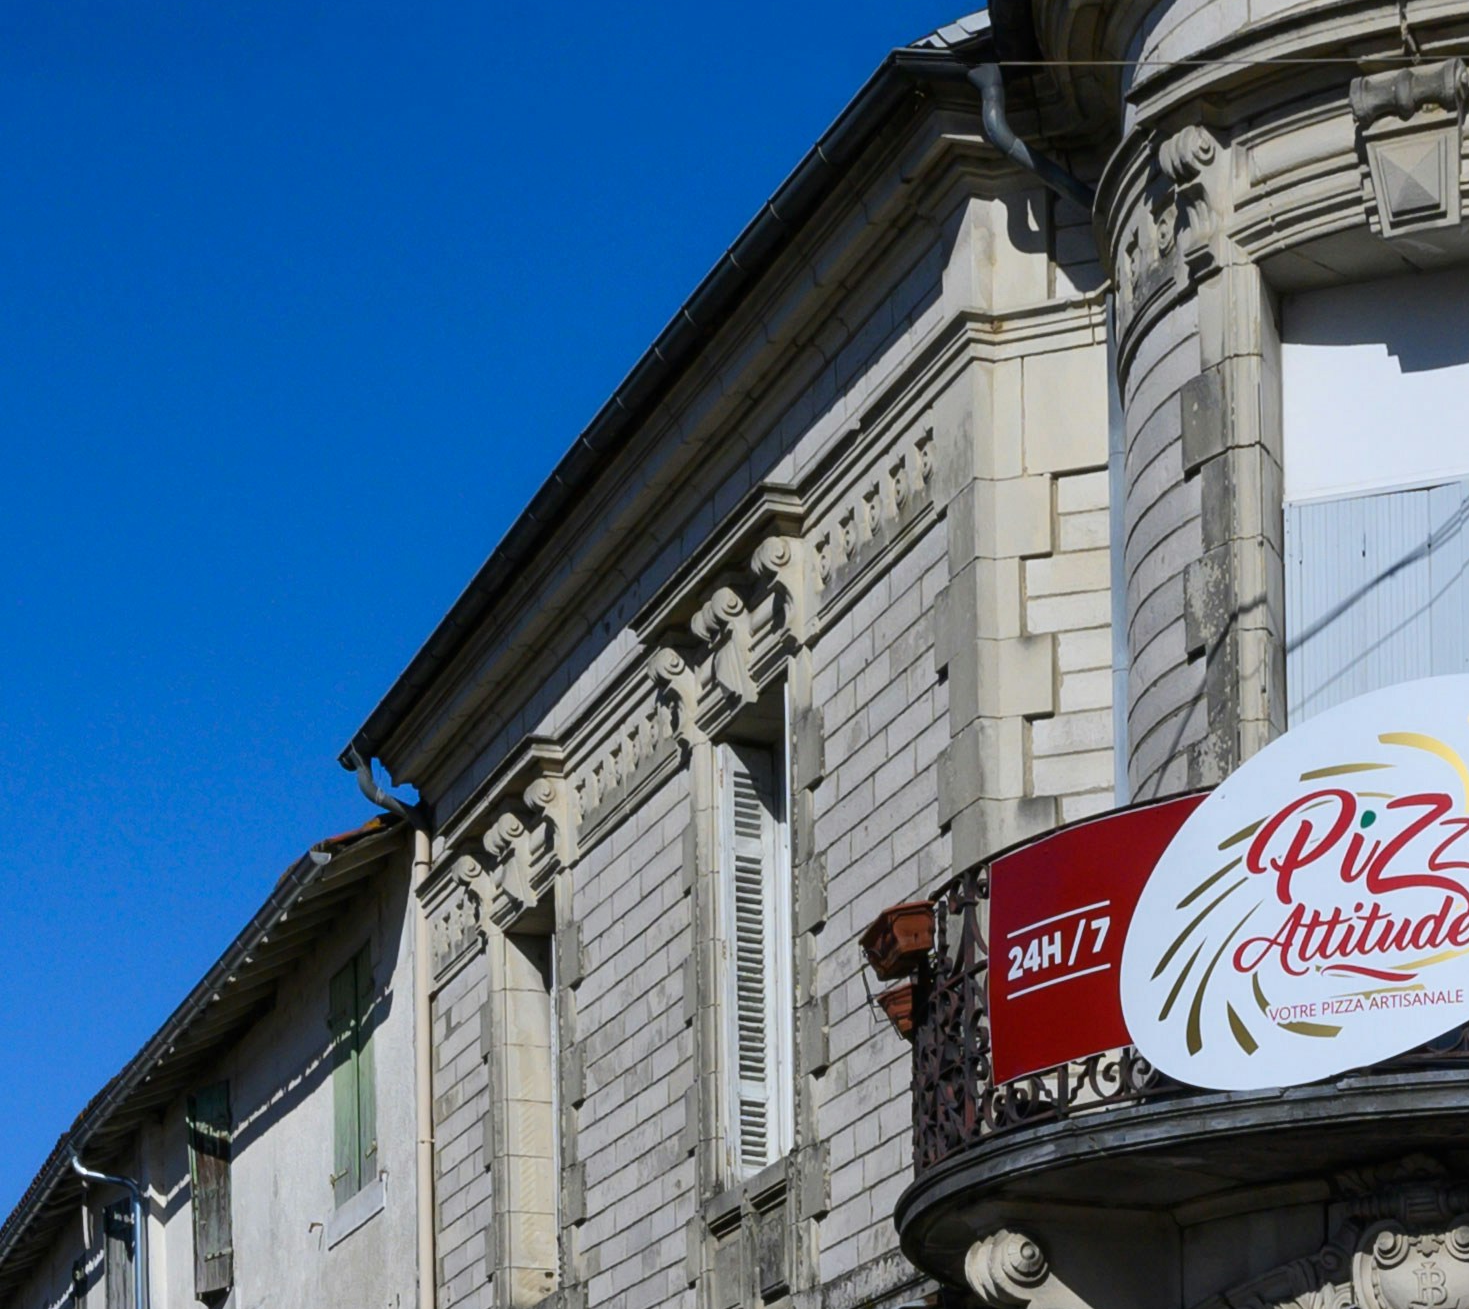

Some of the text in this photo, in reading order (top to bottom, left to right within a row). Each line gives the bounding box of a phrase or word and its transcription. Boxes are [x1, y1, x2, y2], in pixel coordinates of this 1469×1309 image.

[1007, 931, 1062, 981] 24H
[1267, 988, 1464, 1023] VOTRE PIZZA ARTISANALE
